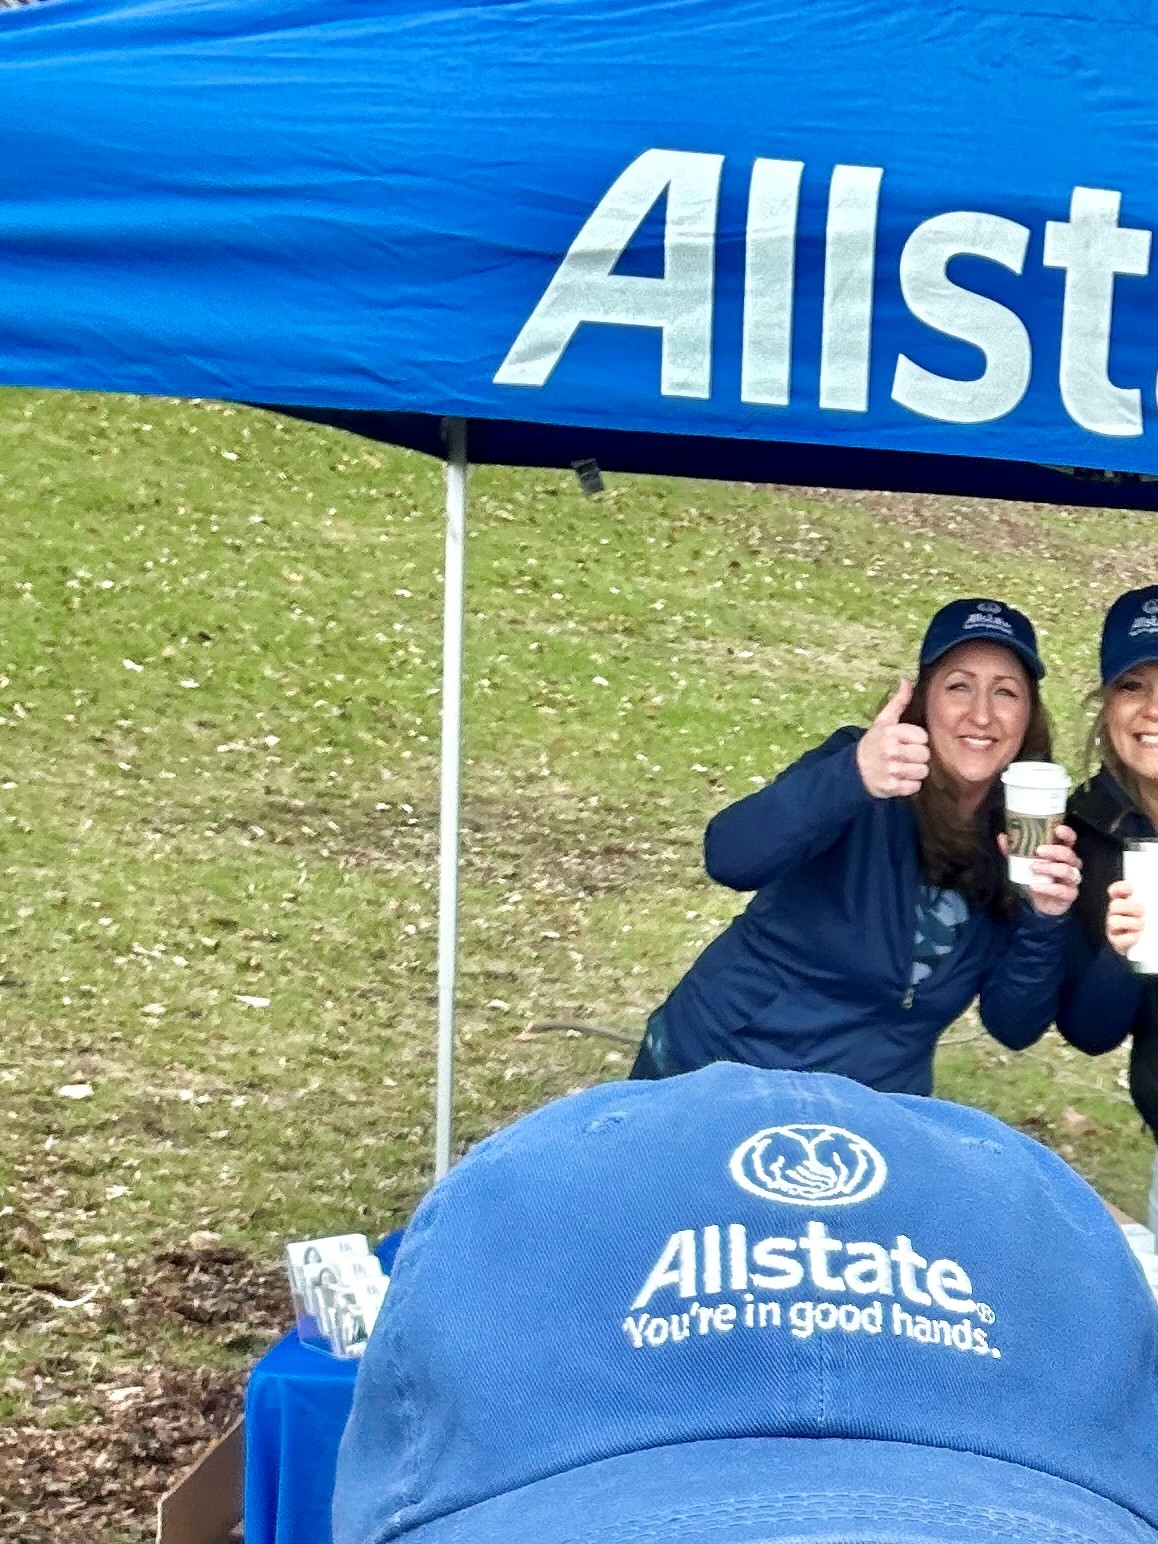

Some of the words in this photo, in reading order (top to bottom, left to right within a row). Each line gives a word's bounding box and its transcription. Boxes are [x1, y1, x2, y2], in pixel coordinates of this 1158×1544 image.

[623, 1302, 737, 1348] You're
[744, 1293, 781, 1328] in
[789, 1300, 883, 1339] good
[892, 1302, 1002, 1359] hands.
